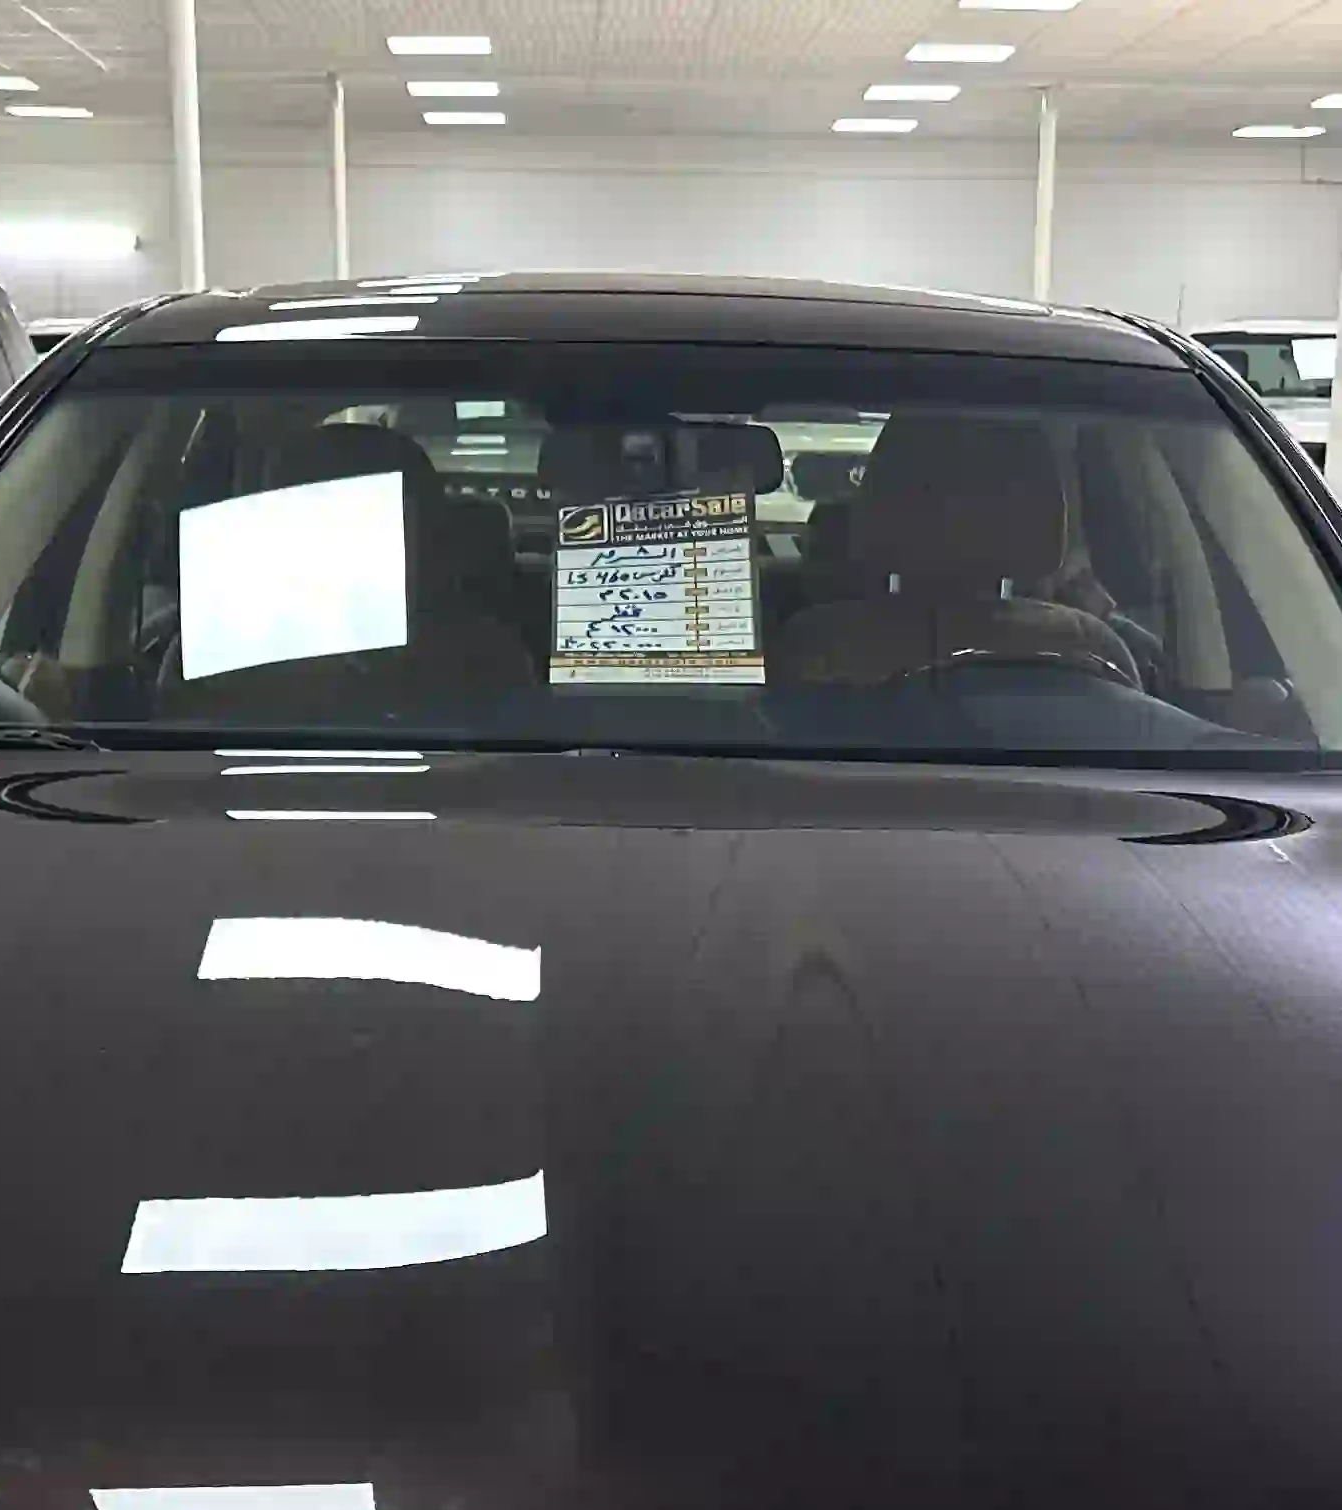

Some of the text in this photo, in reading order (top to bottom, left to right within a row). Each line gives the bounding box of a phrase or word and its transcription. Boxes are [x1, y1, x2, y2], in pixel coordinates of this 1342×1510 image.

[614, 497, 747, 522] QatarSale
[615, 534, 633, 542] THE
[635, 532, 674, 541] MARKET
